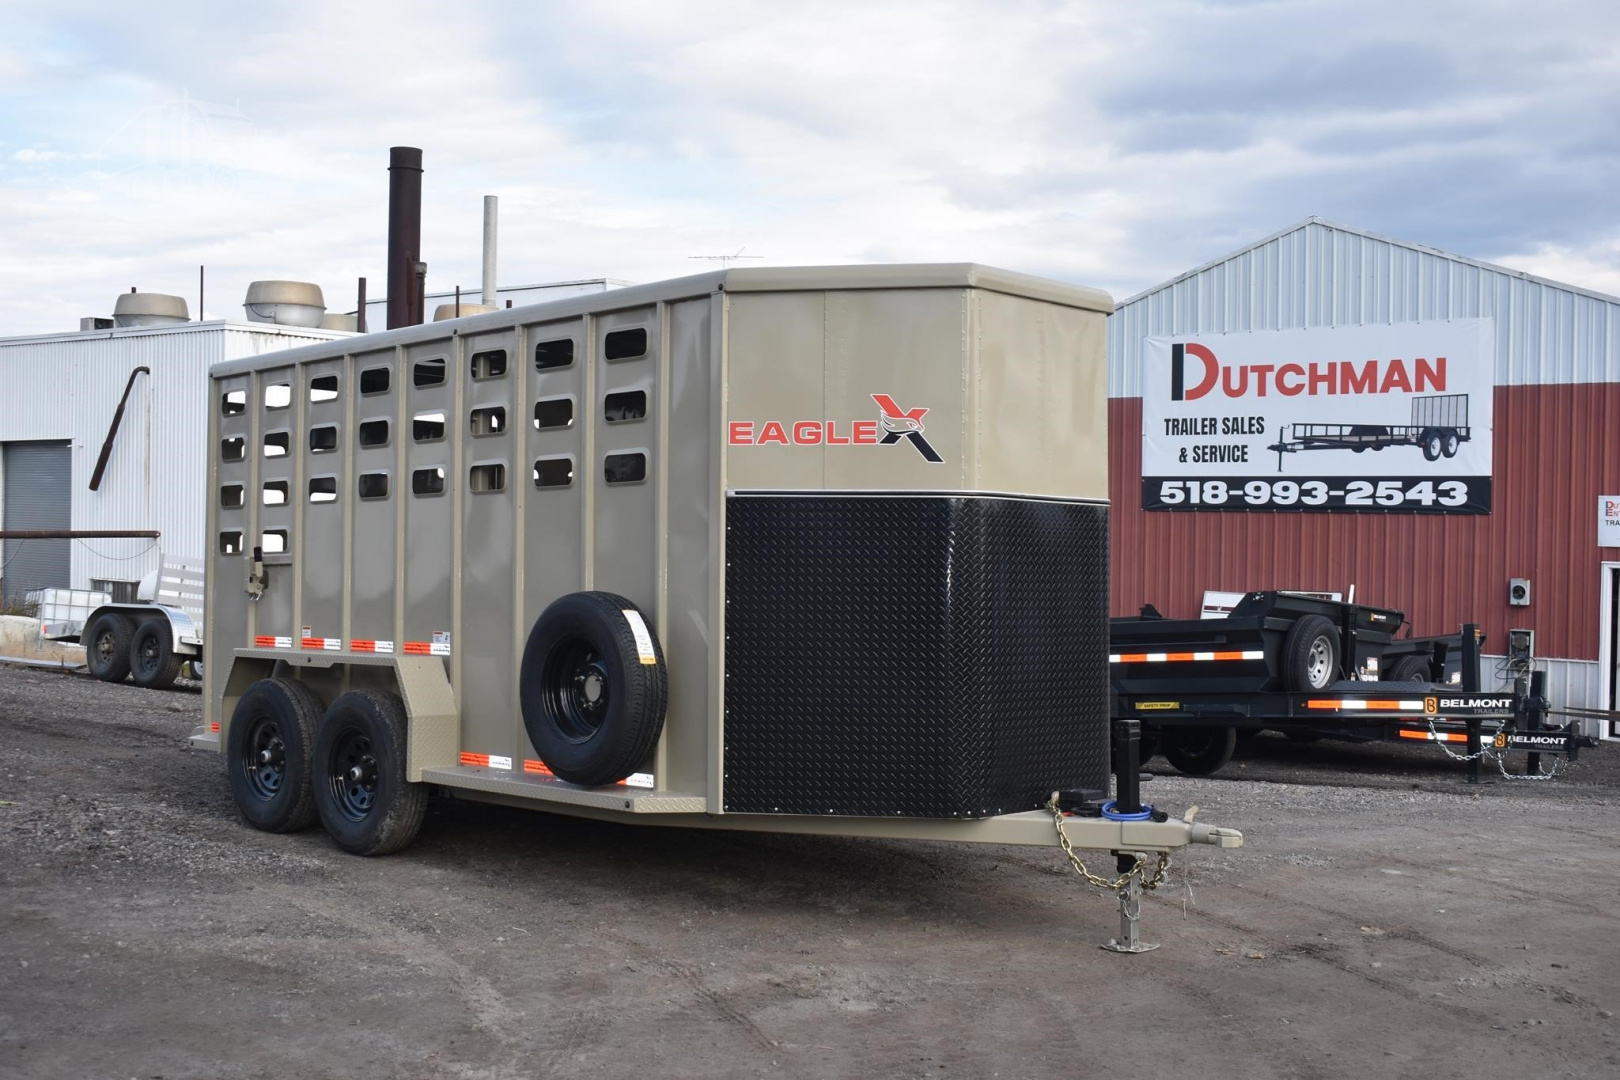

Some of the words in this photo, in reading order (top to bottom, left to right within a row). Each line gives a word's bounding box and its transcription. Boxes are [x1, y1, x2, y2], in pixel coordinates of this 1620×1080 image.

[1171, 342, 1447, 401] DUTCHMAN
[1164, 417, 1218, 436] TRAILER
[1221, 416, 1265, 435] SALES
[1178, 447, 1188, 463] &
[1192, 444, 1249, 463] SERVICE
[1159, 480, 1469, 506] 518-993-2543
[1605, 500, 1620, 509] DU
[1440, 698, 1512, 708] BELMONT
[1507, 735, 1567, 744] BELMONT
